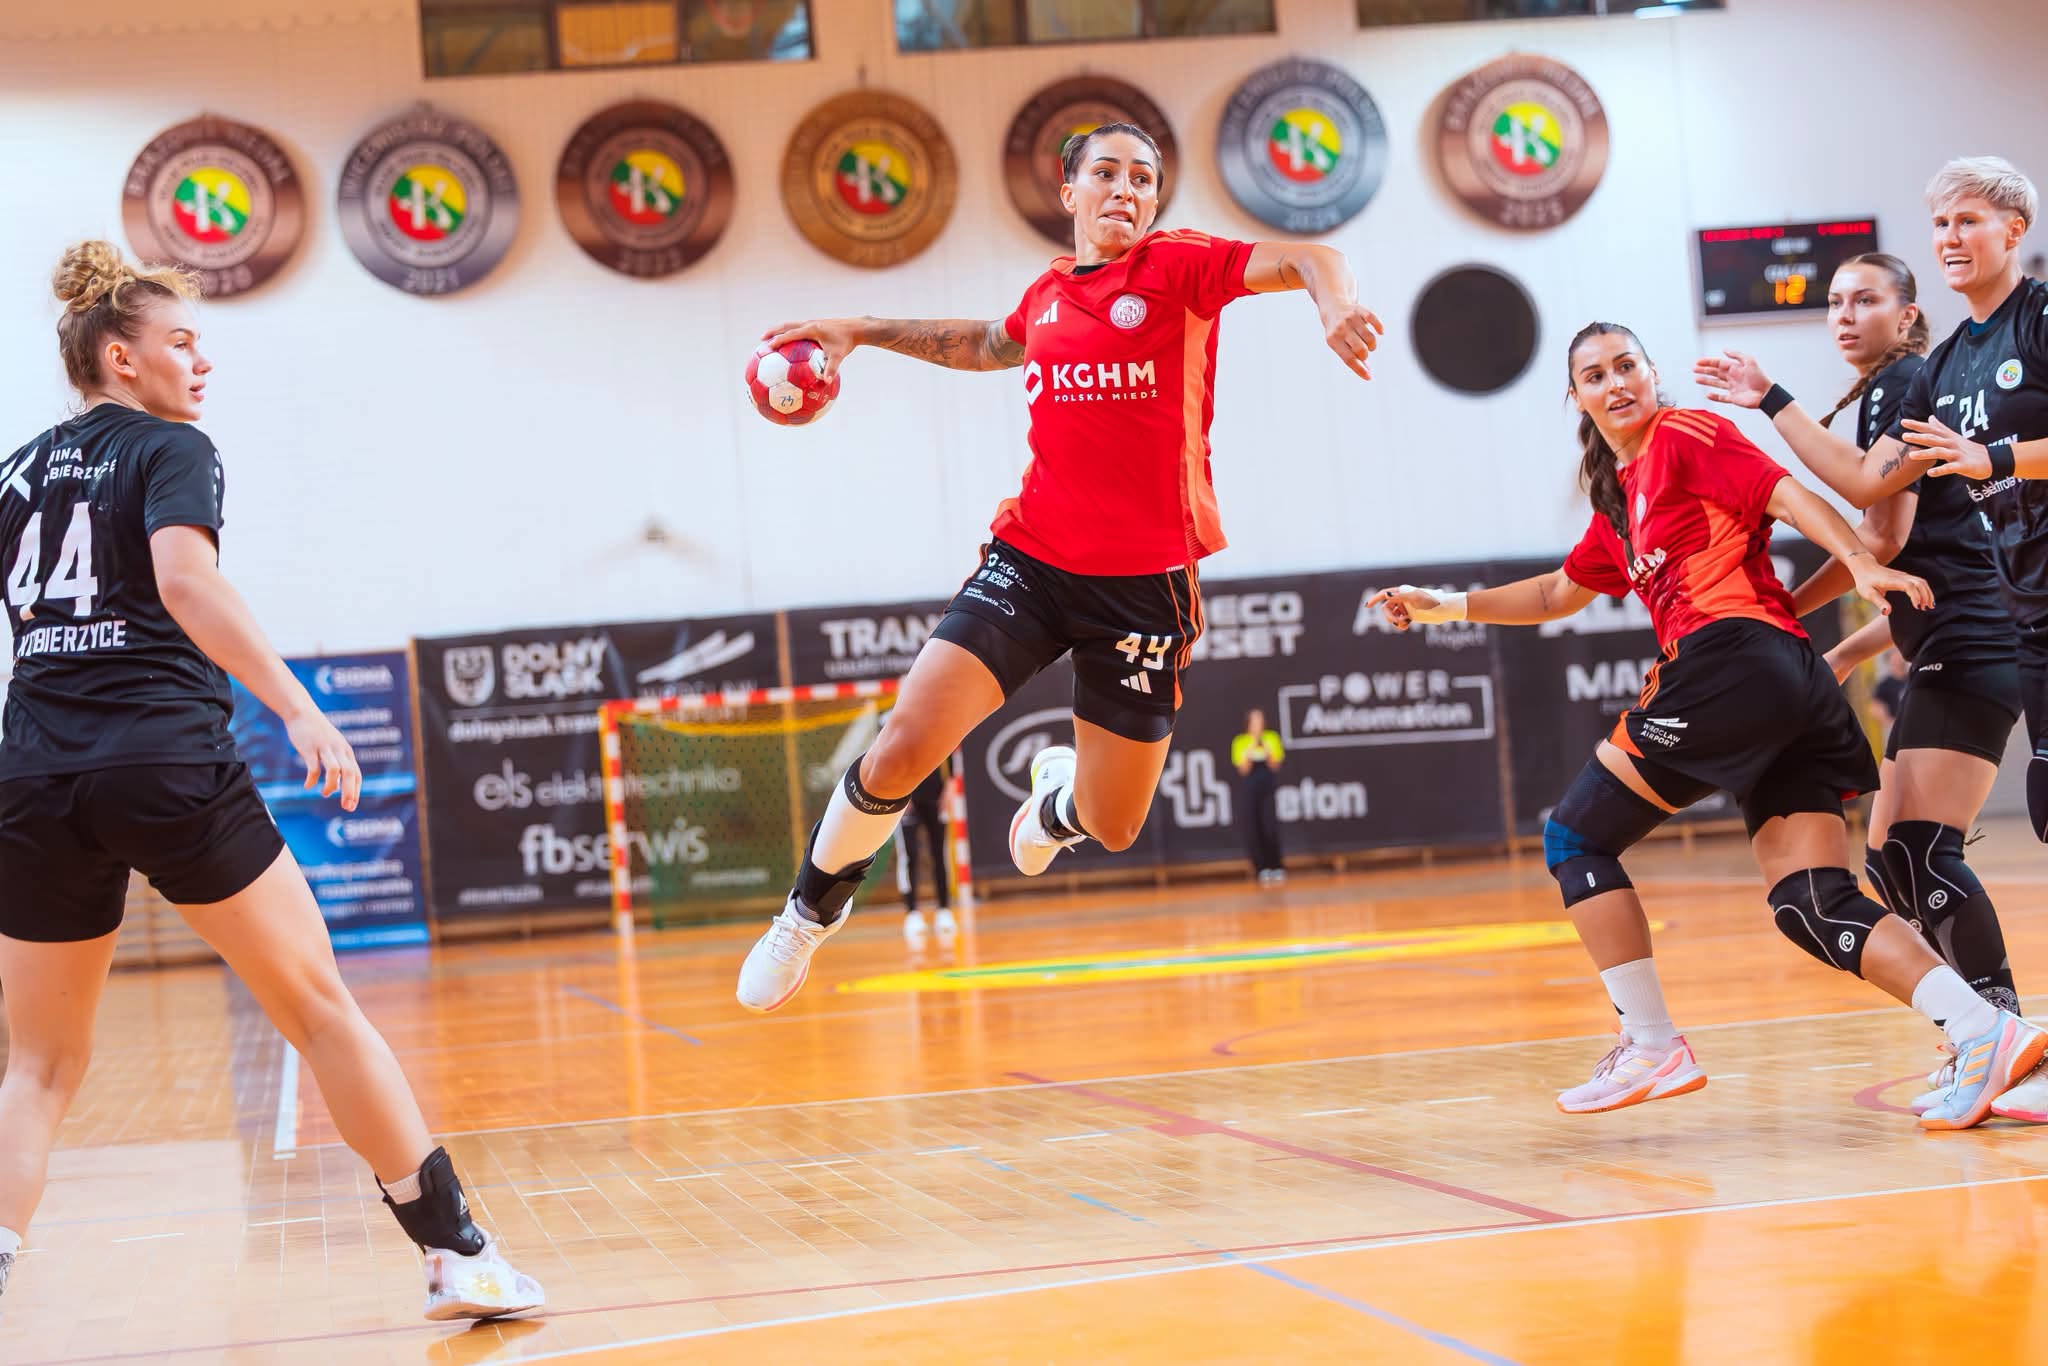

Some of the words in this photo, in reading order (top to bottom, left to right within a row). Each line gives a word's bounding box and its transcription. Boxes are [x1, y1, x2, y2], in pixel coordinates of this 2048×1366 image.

[1052, 360, 1157, 390] KGHM
[1054, 393, 1104, 404] POLSKA
[1959, 389, 1990, 440] 24
[7, 501, 98, 621] 44
[1203, 592, 1304, 625] ECO
[502, 638, 609, 674] DOLNY
[1192, 624, 1305, 660] SET
[1302, 699, 1473, 735] Automation
[1640, 730, 1675, 748] AIRPORT
